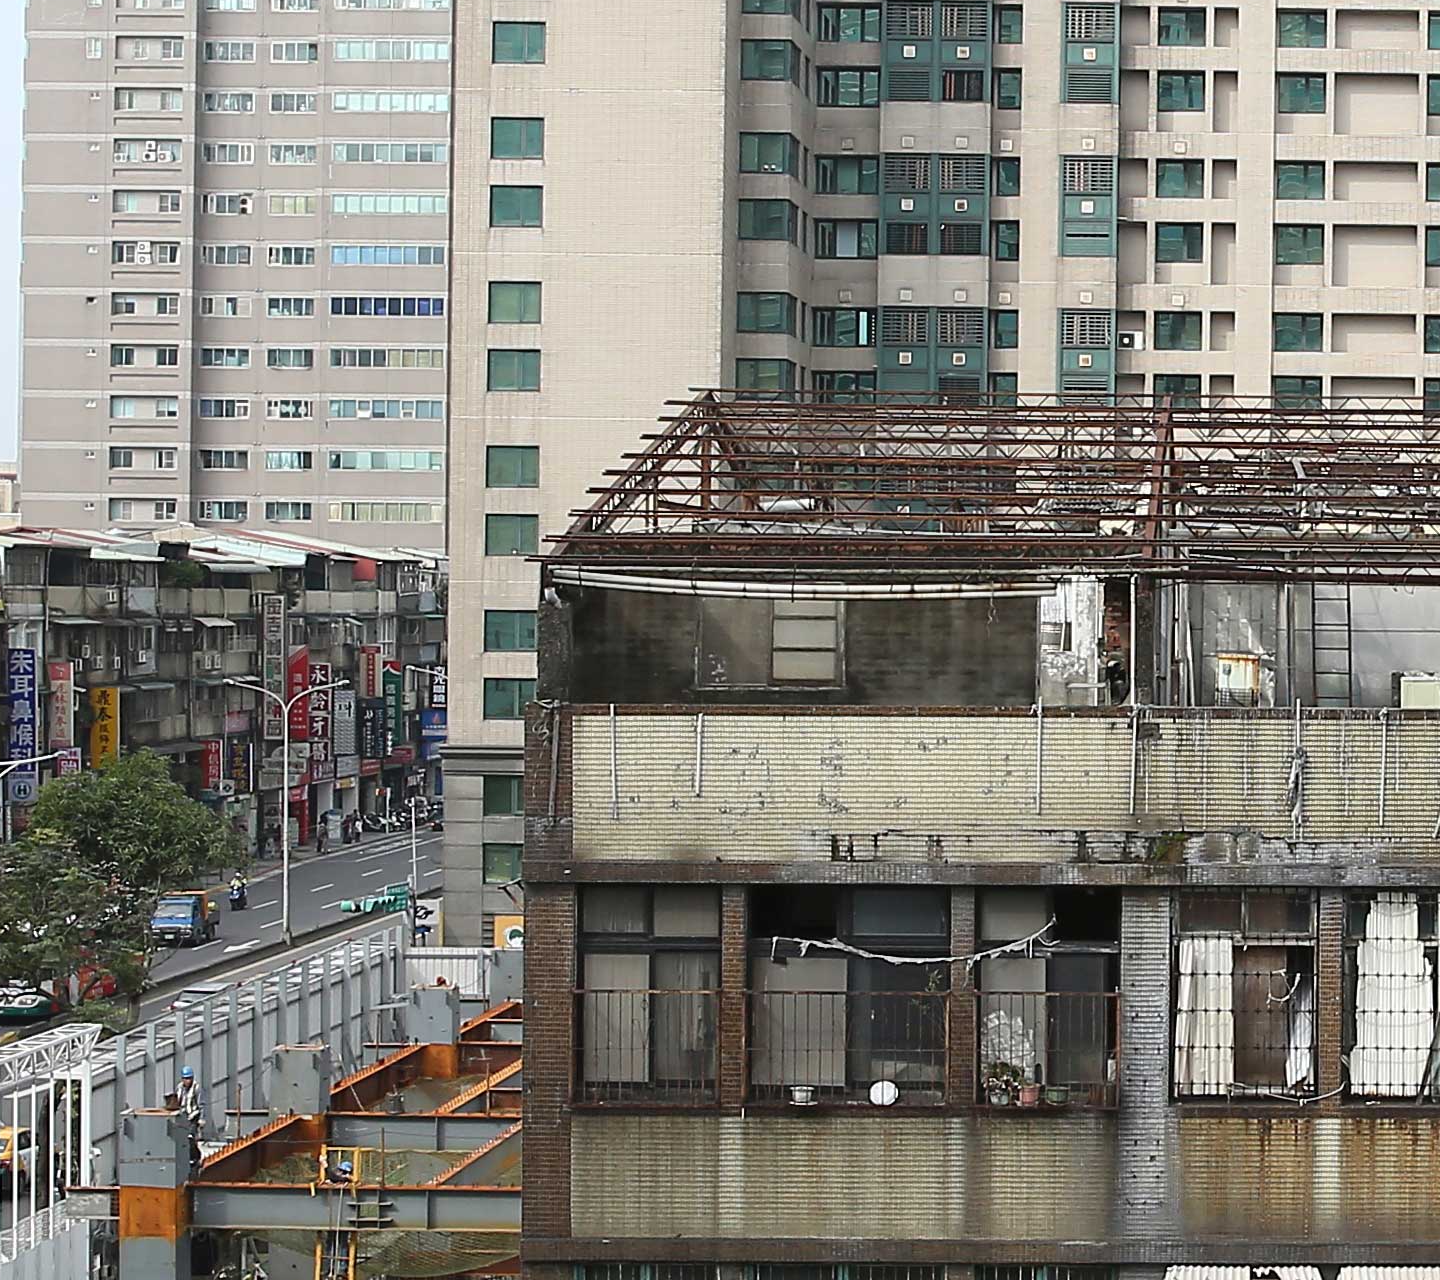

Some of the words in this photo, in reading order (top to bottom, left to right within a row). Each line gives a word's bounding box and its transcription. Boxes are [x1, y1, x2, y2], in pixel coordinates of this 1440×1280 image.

[10, 650, 34, 771] 朱耳鼻喉科
